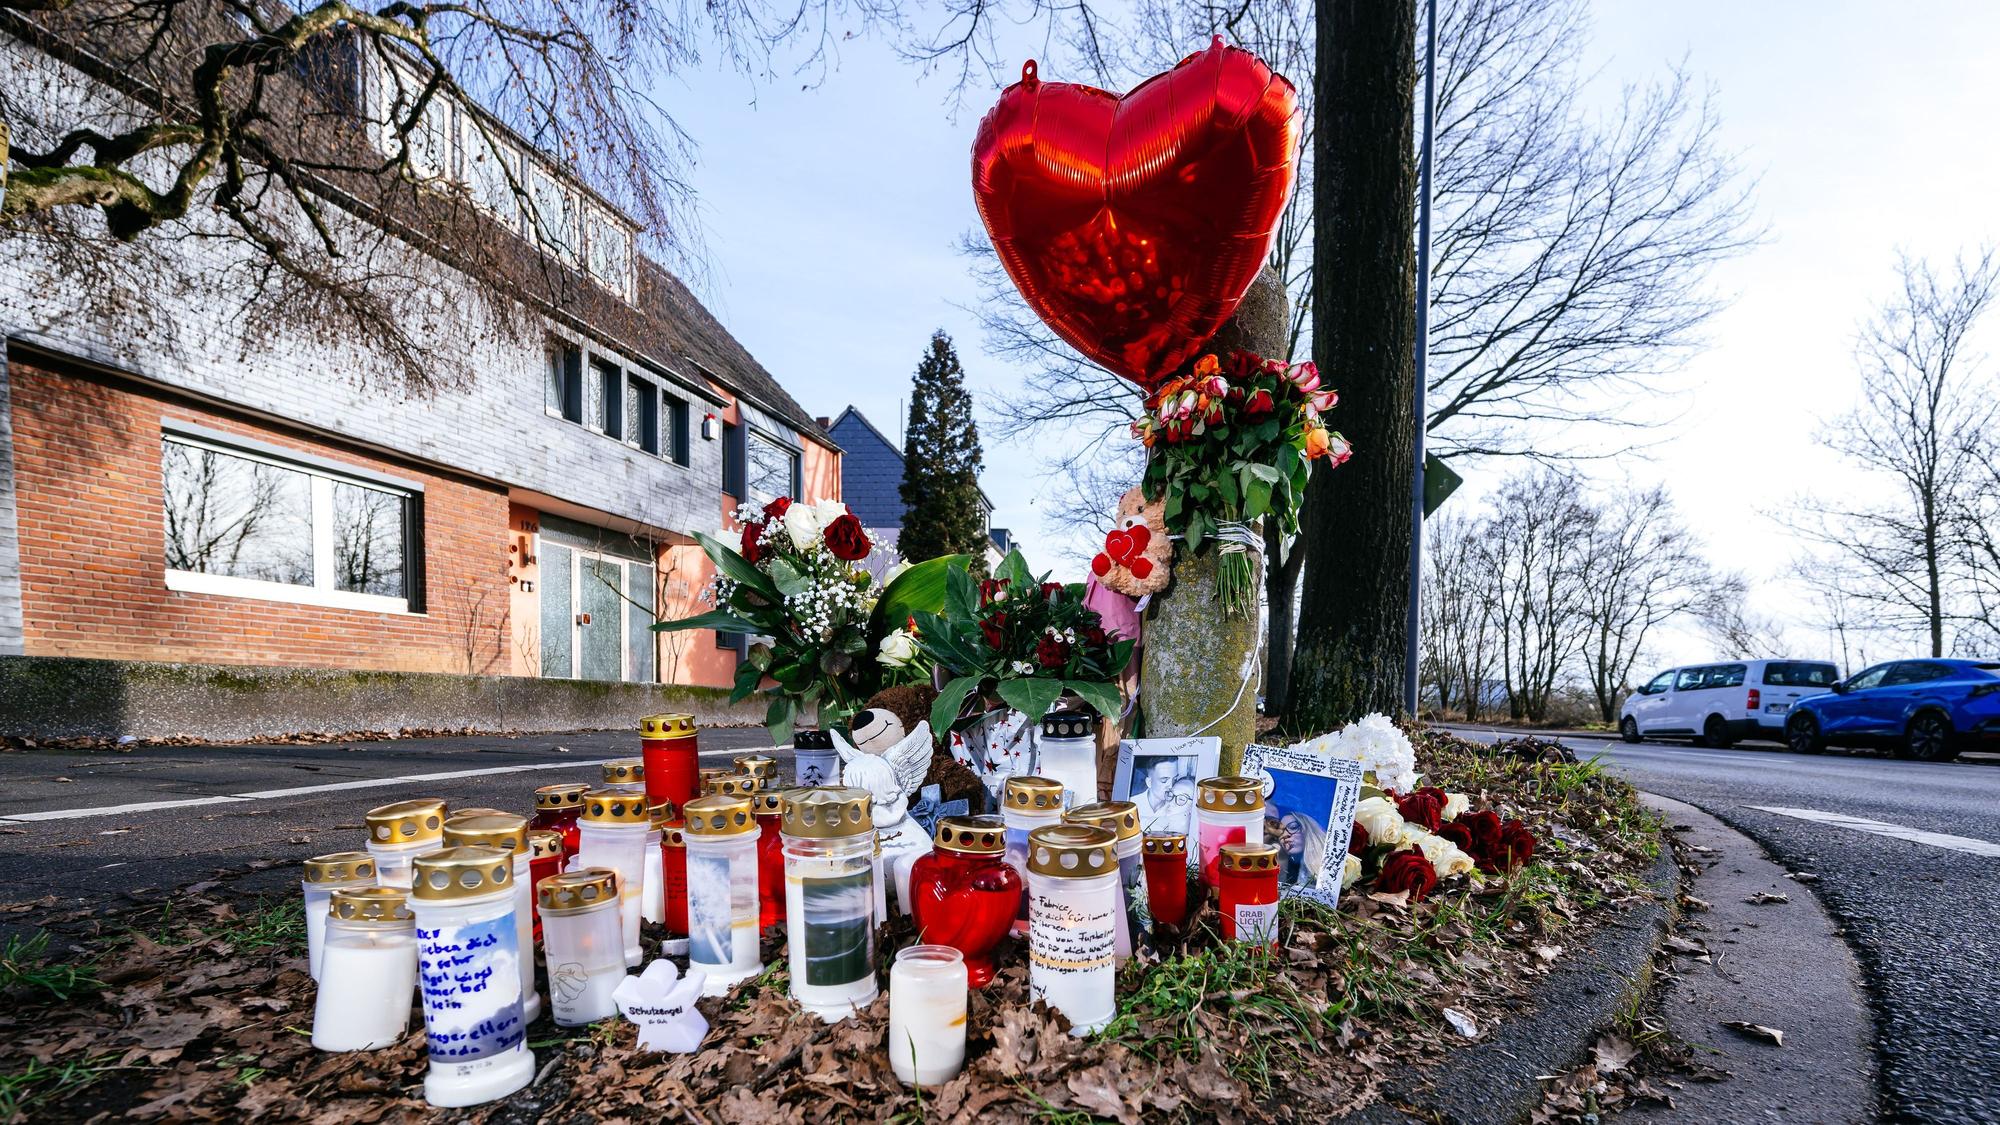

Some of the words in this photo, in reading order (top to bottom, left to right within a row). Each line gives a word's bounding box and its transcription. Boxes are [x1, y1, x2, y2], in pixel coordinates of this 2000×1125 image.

[1239, 910, 1263, 918] GRAB
[1239, 917, 1263, 926] LICHT
[628, 1005, 684, 1017] Schutzengel
